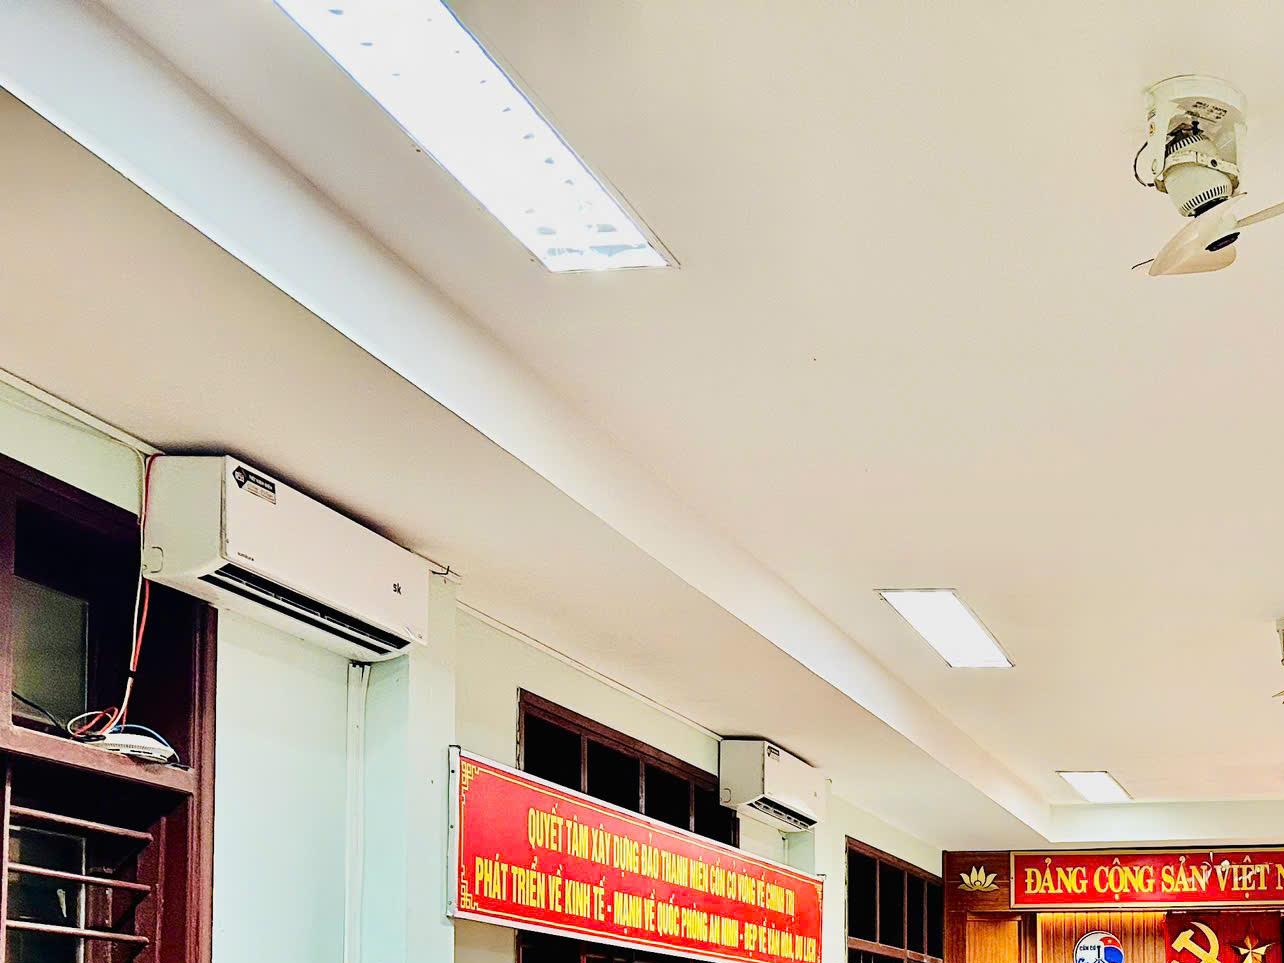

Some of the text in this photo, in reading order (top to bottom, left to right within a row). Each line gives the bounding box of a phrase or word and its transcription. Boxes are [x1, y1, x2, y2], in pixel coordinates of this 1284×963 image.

[528, 803, 563, 852] QUYẾT
[566, 815, 589, 860] TÂM
[591, 823, 611, 866] XÂY
[614, 834, 639, 877] DỰNG
[641, 832, 659, 880] ĐẢO
[661, 849, 688, 887] THANH
[690, 856, 709, 897] NIÊN
[710, 857, 726, 897] CỒN
[726, 861, 736, 900] CỎ
[1024, 858, 1088, 894] ĐẢNG
[1093, 858, 1155, 900] CỘNG
[1161, 856, 1207, 893] SẢN
[1215, 855, 1270, 899] VIỆT
[475, 854, 508, 901] PHÁT
[511, 856, 546, 909] TRIỂN
[548, 864, 562, 912] VỀ
[565, 878, 590, 918] KINH
[593, 876, 605, 921] TẾ
[606, 904, 612, 913] -
[613, 890, 642, 934] MẠNH
[644, 889, 655, 932] VỀ
[657, 894, 680, 936] QUỐC
[681, 902, 708, 943] PHÒNG
[709, 913, 720, 944] AN
[721, 916, 739, 948] NINH
[744, 922, 757, 957] ĐẸP
